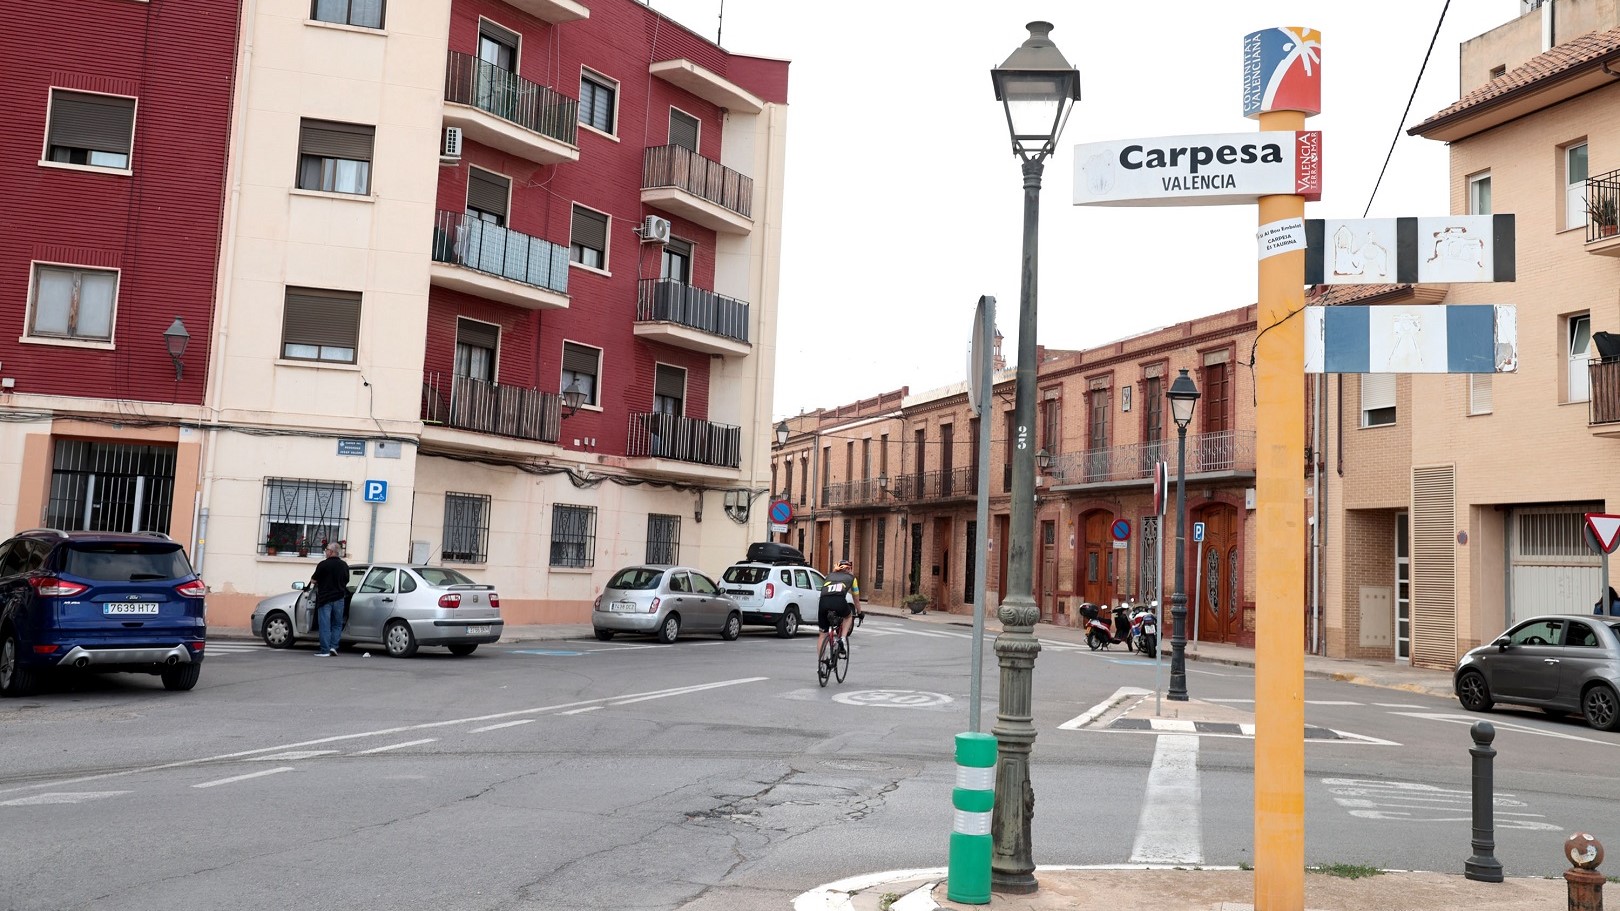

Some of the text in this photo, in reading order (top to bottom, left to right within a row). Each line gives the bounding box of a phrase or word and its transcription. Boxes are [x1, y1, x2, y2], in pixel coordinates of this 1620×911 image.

[1244, 38, 1252, 112] COMUNITAT
[1251, 33, 1261, 110] VALENCIANA
[1119, 142, 1283, 174] Carpesa
[1298, 132, 1311, 192] VALENCIA
[1162, 174, 1236, 191] VALENCIA
[1267, 234, 1292, 244] CARPESA
[1273, 239, 1297, 248] TAURINA
[368, 482, 383, 500] P
[1195, 525, 1202, 539] P
[110, 603, 156, 613] 7639 HTZ
